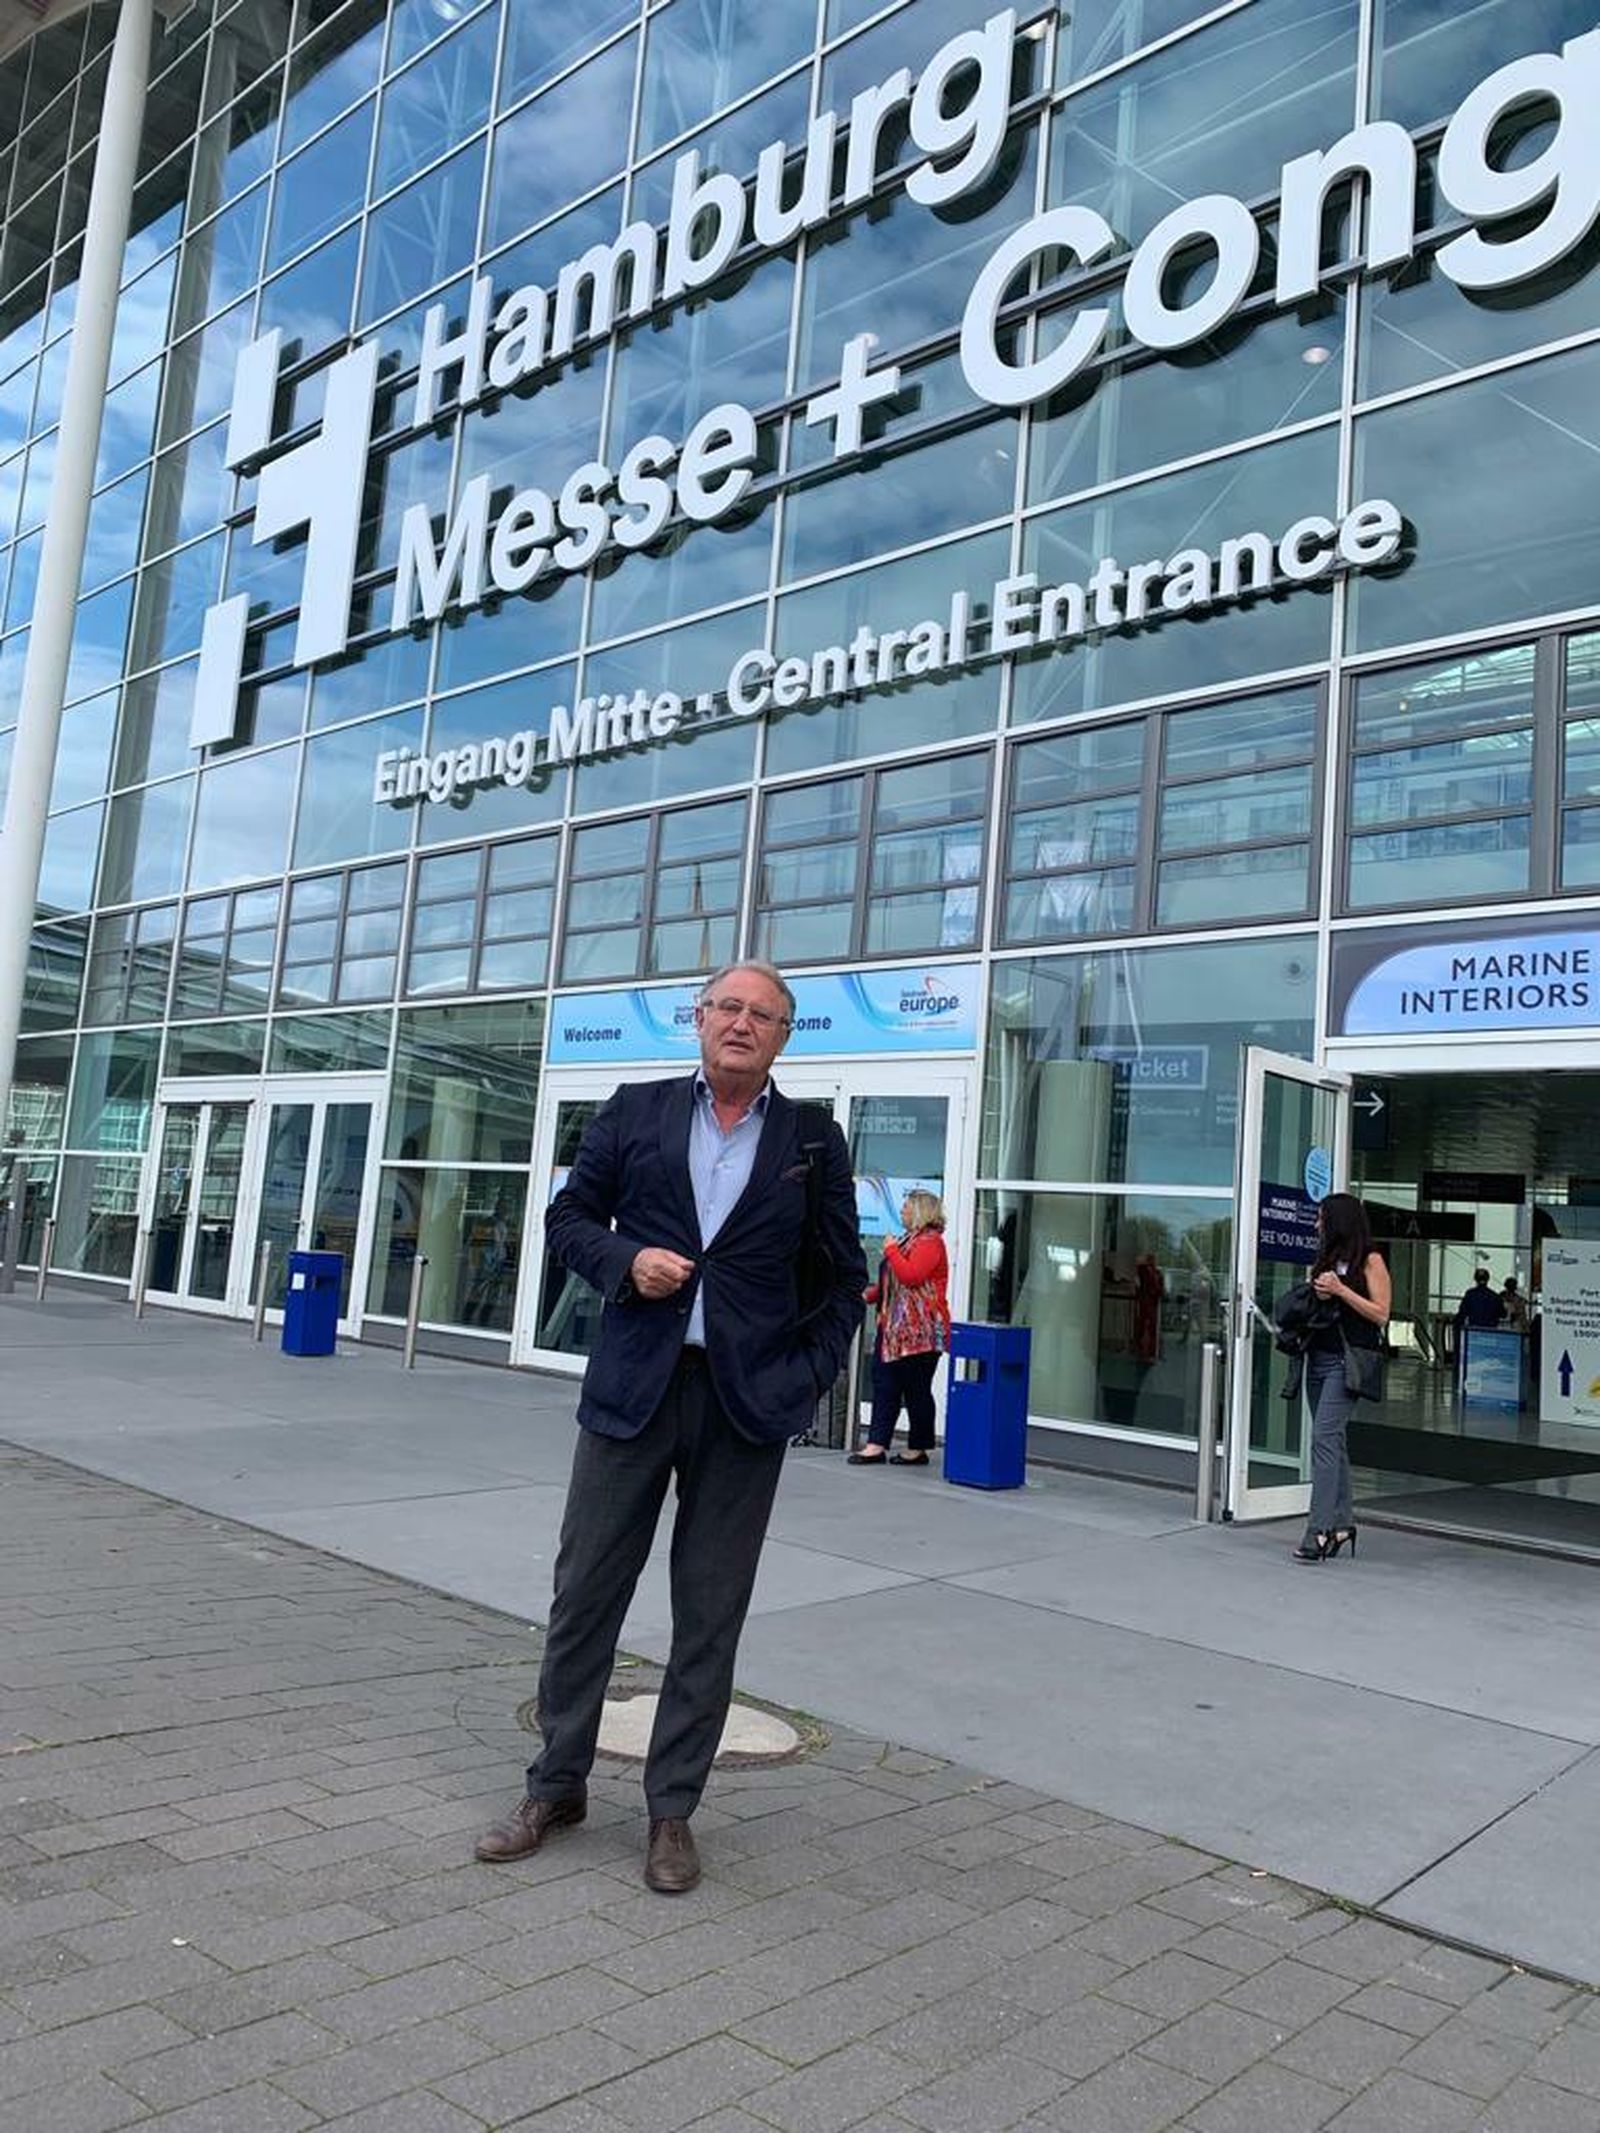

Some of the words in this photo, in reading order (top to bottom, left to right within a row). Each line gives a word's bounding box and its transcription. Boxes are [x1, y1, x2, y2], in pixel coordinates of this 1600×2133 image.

[414, 6, 1017, 429] Hamburg
[390, 402, 758, 632] Messe
[960, 28, 1600, 406] Cong
[374, 730, 536, 804] Eingang
[548, 687, 683, 762] Mitte
[727, 590, 968, 717] Central
[990, 498, 1402, 653] Entrance
[1452, 949, 1590, 981] MARINE
[899, 995, 960, 1014] europe
[1401, 982, 1589, 1015] INTERIORS
[563, 1027, 622, 1043] Welcome
[1119, 1057, 1189, 1078] Ticket
[1260, 1229, 1276, 1245] SEE
[1276, 1232, 1295, 1247] YOU
